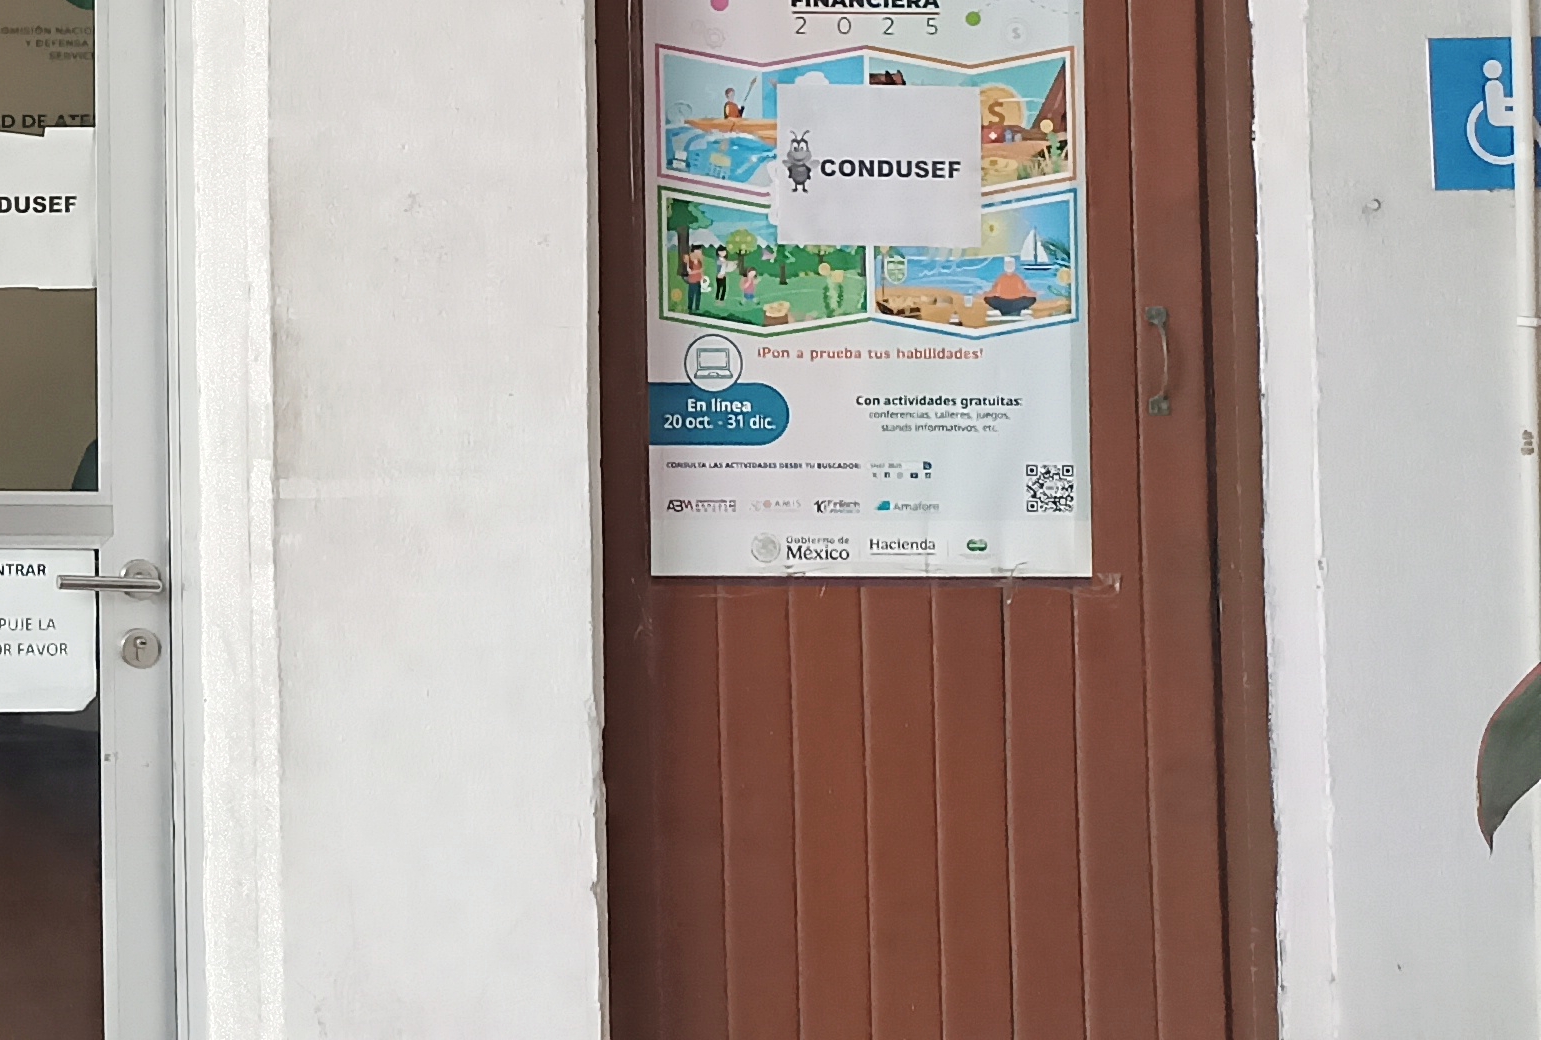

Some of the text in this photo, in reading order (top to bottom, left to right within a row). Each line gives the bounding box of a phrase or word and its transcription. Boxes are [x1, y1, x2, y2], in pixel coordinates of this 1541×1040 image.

[22, 114, 47, 128] DE
[820, 160, 961, 179] CONDUSEF
[797, 350, 803, 359] a
[810, 348, 861, 361] prueba
[868, 349, 890, 359] tus
[687, 399, 706, 412] En
[856, 396, 880, 405] Con
[883, 396, 956, 406] actividades
[664, 415, 682, 428] 20
[686, 415, 712, 429] oct.
[727, 415, 743, 428] 31
[750, 414, 776, 429] dic.
[838, 536, 849, 544] de
[869, 538, 936, 551] Hacienda
[786, 544, 849, 560] México
[39, 618, 56, 631] LA
[17, 642, 68, 655] FAVOR
